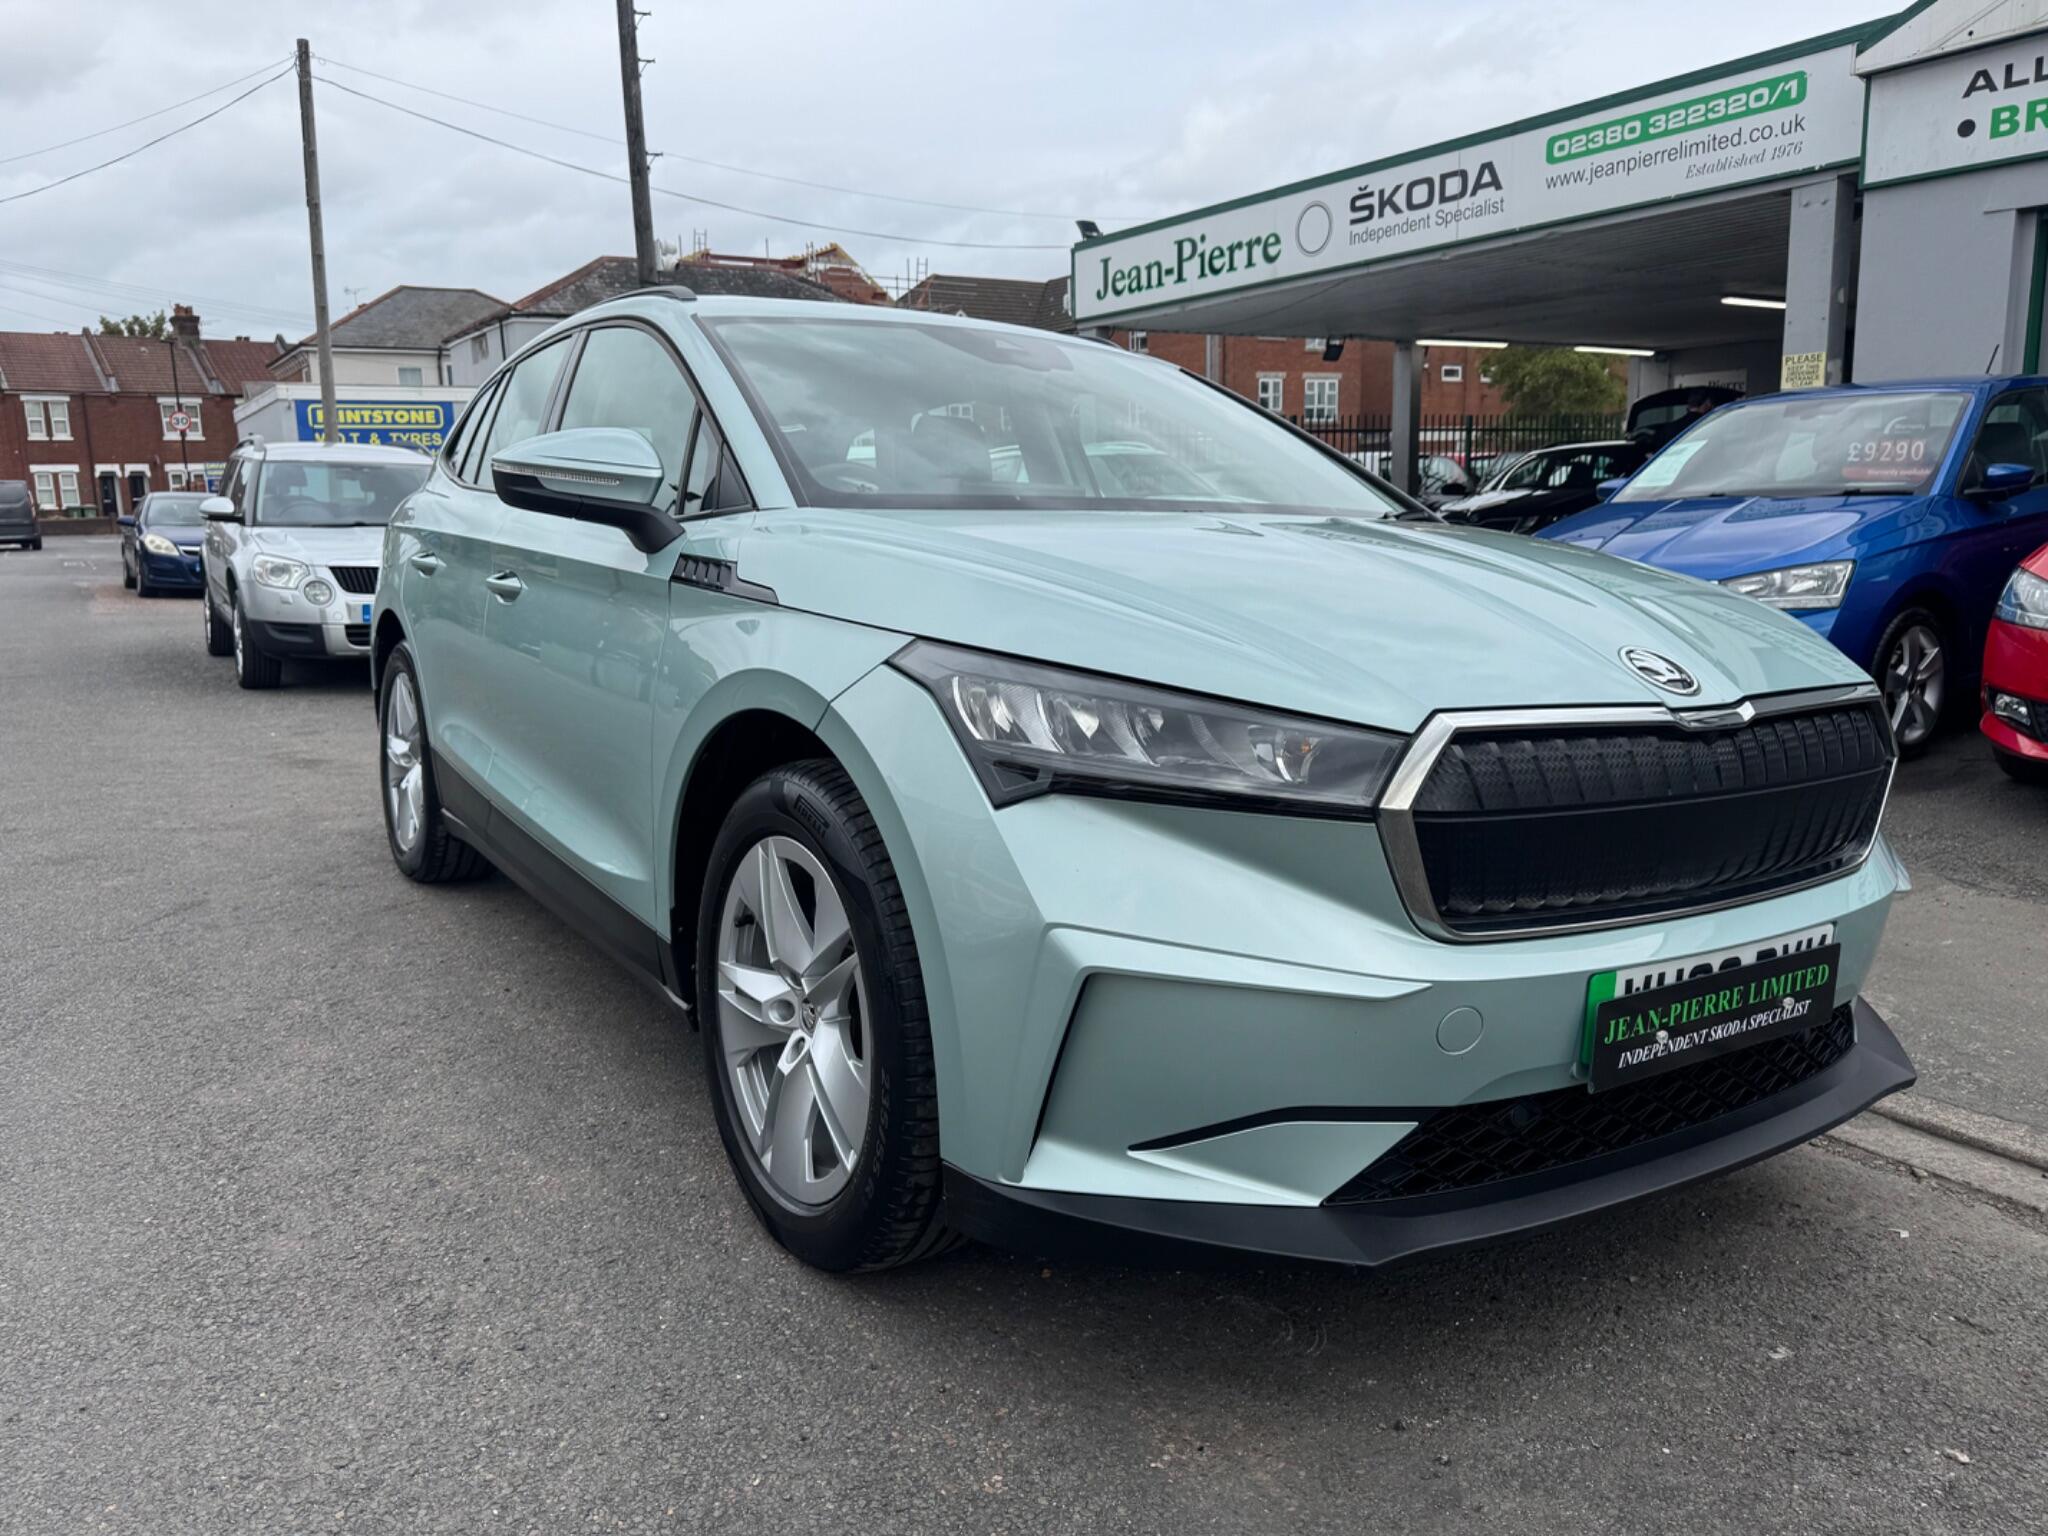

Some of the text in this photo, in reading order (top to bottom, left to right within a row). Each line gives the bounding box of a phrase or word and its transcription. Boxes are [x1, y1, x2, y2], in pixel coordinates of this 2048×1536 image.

[1553, 79, 1799, 158] 02380 322320/1
[1546, 113, 1806, 189] www.jeanpierrelimited.co.uk
[1685, 141, 1803, 180] Established 1976
[1350, 161, 1503, 226] ŠKODA
[1350, 197, 1504, 246] Independent Specialist
[1096, 232, 1282, 301] Jean-Pierre
[1785, 353, 1823, 366] PLEASE
[173, 416, 188, 426] 30
[316, 410, 436, 423] INTSTONE
[370, 432, 380, 446] &
[389, 432, 442, 446] TYRES
[1847, 441, 1924, 462] £9290
[1604, 985, 1744, 1045] JEAN-PIERRE
[1749, 963, 1830, 1004] LIMITED
[1618, 1000, 1812, 1070] INDEPENDENT SKODA SPECIALIST
